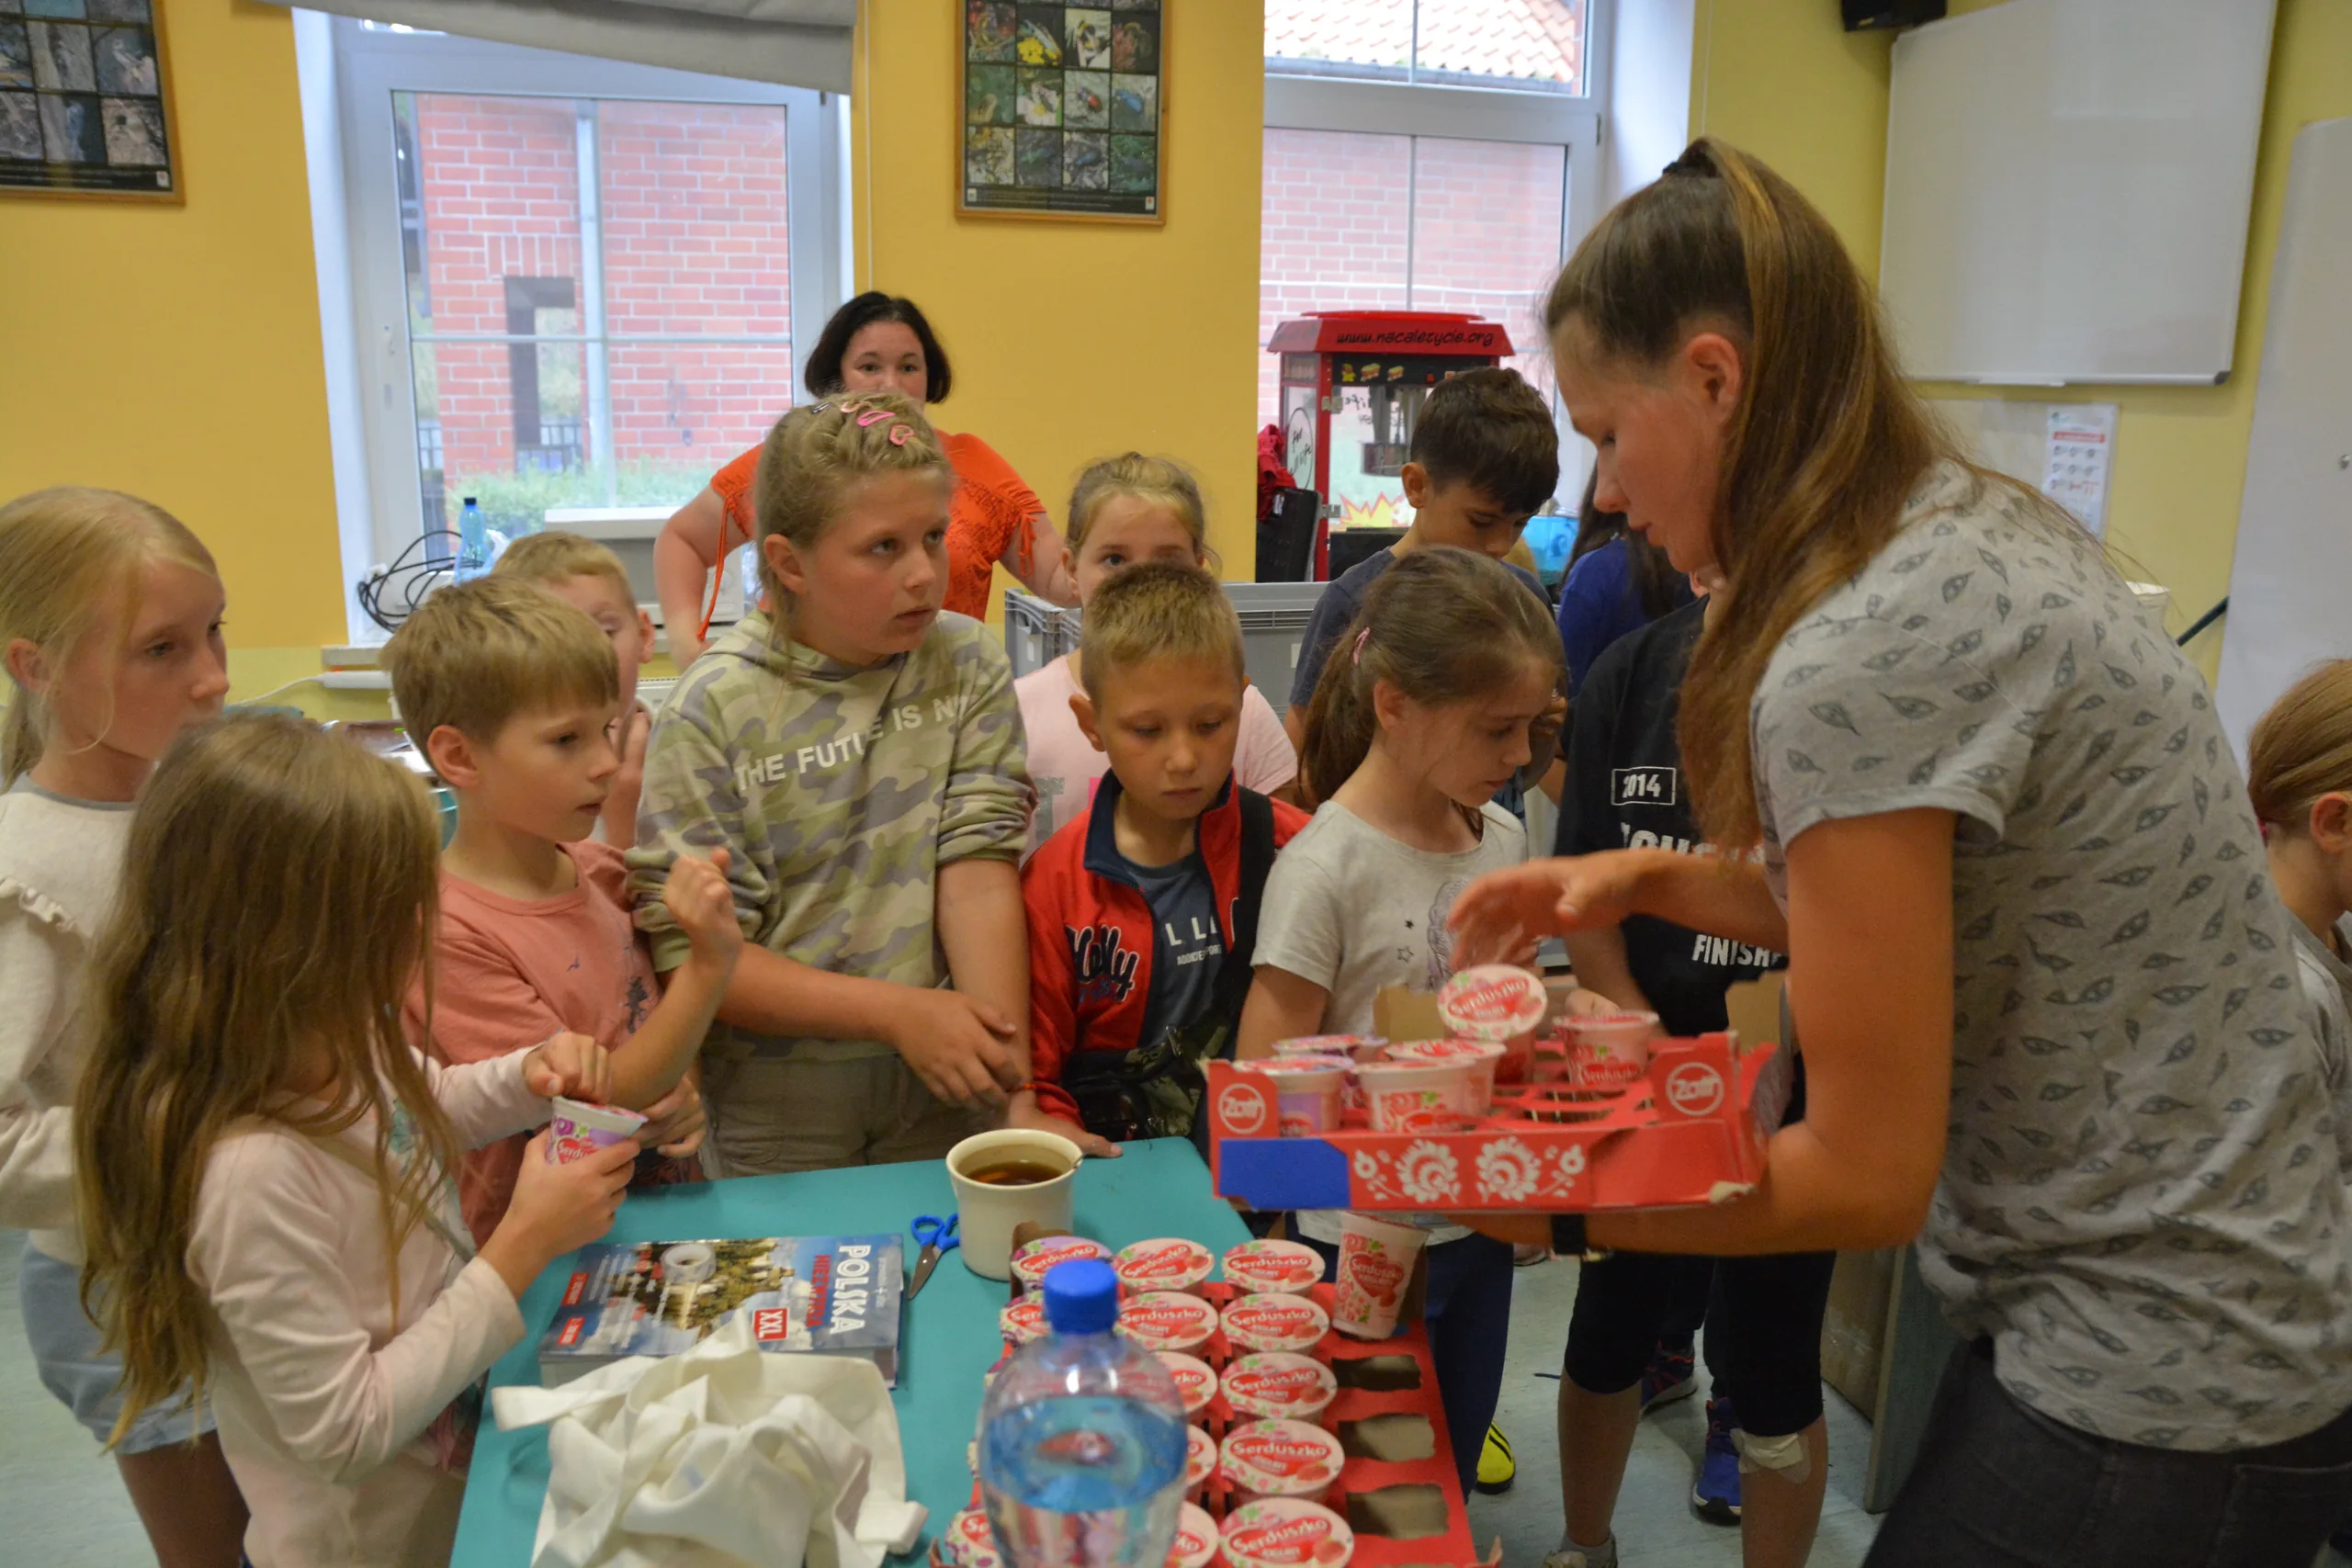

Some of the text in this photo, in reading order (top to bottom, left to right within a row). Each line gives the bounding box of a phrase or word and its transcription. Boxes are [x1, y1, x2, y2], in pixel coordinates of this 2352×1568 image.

[735, 753, 787, 791] THE
[797, 716, 884, 773] FUTUE
[892, 705, 922, 731] IS
[1230, 1255, 1310, 1269] Serduszko
[829, 1245, 871, 1335] POLSKA
[757, 1309, 786, 1339] XXL
[1120, 1306, 1204, 1324] Serduszko
[1230, 1308, 1313, 1327] Serduszko
[1230, 1370, 1317, 1391] Serduszko
[1232, 1440, 1328, 1456] Serduszko
[1232, 1518, 1329, 1551] Serduszko
